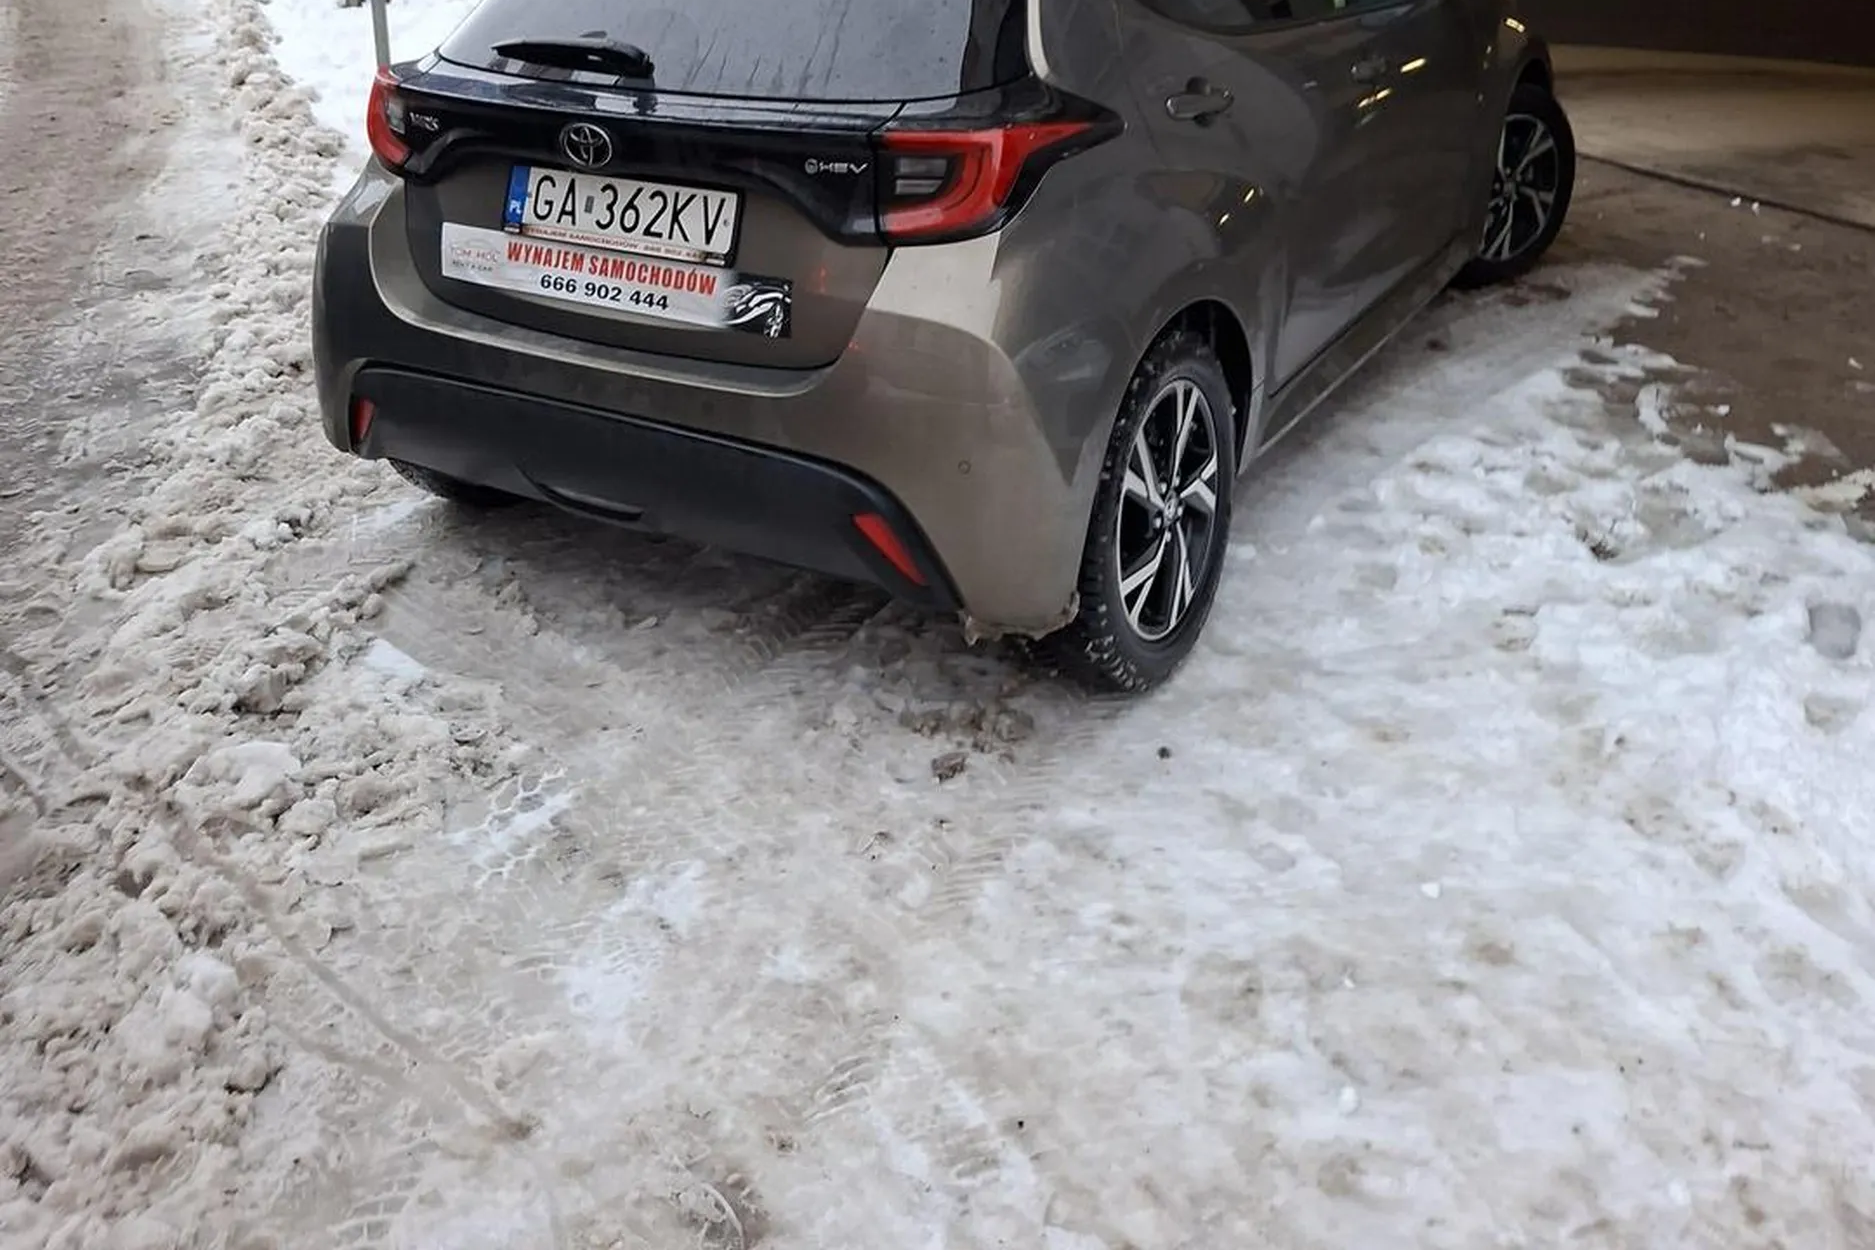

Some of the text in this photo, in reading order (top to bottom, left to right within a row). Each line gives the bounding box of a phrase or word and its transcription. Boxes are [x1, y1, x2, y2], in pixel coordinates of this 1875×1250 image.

[509, 199, 521, 214] PL
[533, 175, 726, 245] GA 362KV
[507, 241, 717, 295] WYNAJEM SAMOCHODÓW
[540, 273, 669, 310] 666 902 444
